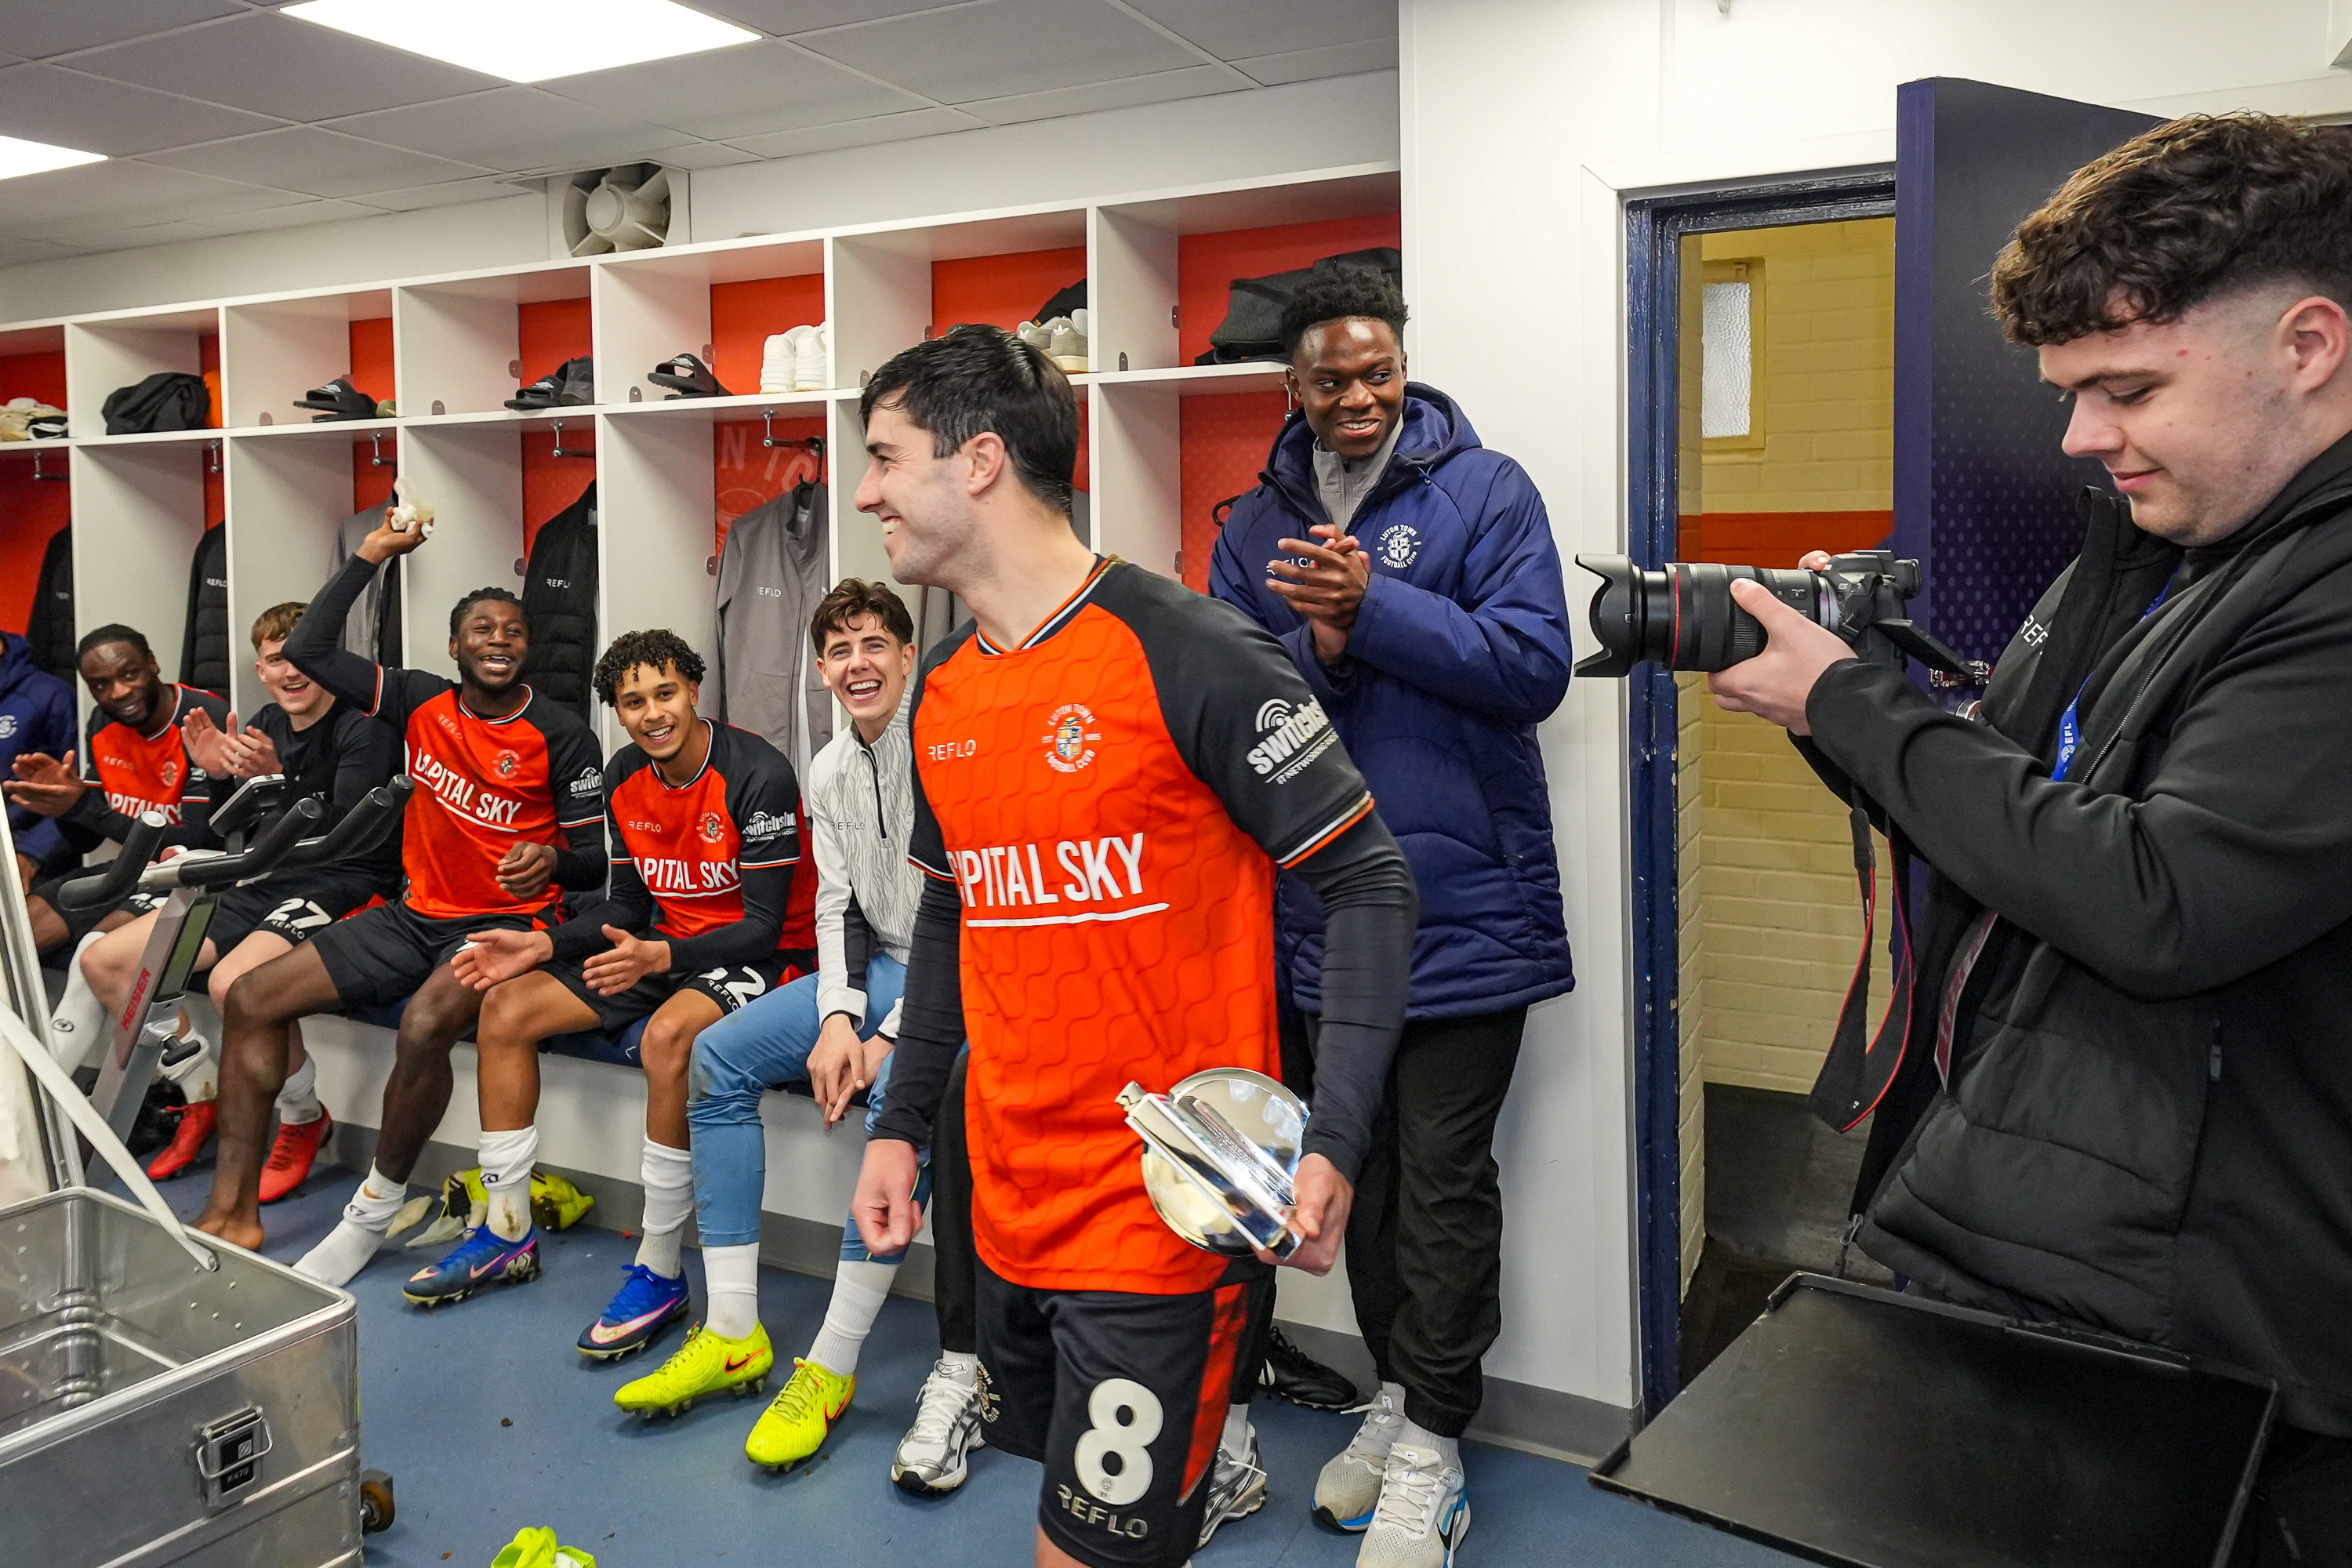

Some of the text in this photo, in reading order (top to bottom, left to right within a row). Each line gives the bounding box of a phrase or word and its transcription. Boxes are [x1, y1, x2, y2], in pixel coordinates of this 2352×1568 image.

[1380, 524, 1417, 541] LUTON TOWN
[1381, 555, 1407, 568] FOOTBALL
[546, 579, 571, 588] REFL
[2020, 614, 2049, 655] REF
[2063, 722, 2074, 744] EFL
[927, 739, 977, 761] REFLO
[475, 792, 522, 825] SKY
[628, 820, 662, 833] REFLO
[699, 858, 739, 889] SKY
[1056, 832, 1144, 902] SKY
[263, 898, 332, 929] 27
[270, 920, 305, 939] REFLO
[708, 979, 739, 1012] REFLO
[1074, 1377, 1163, 1506] 8
[1058, 1483, 1148, 1538] REFLO
